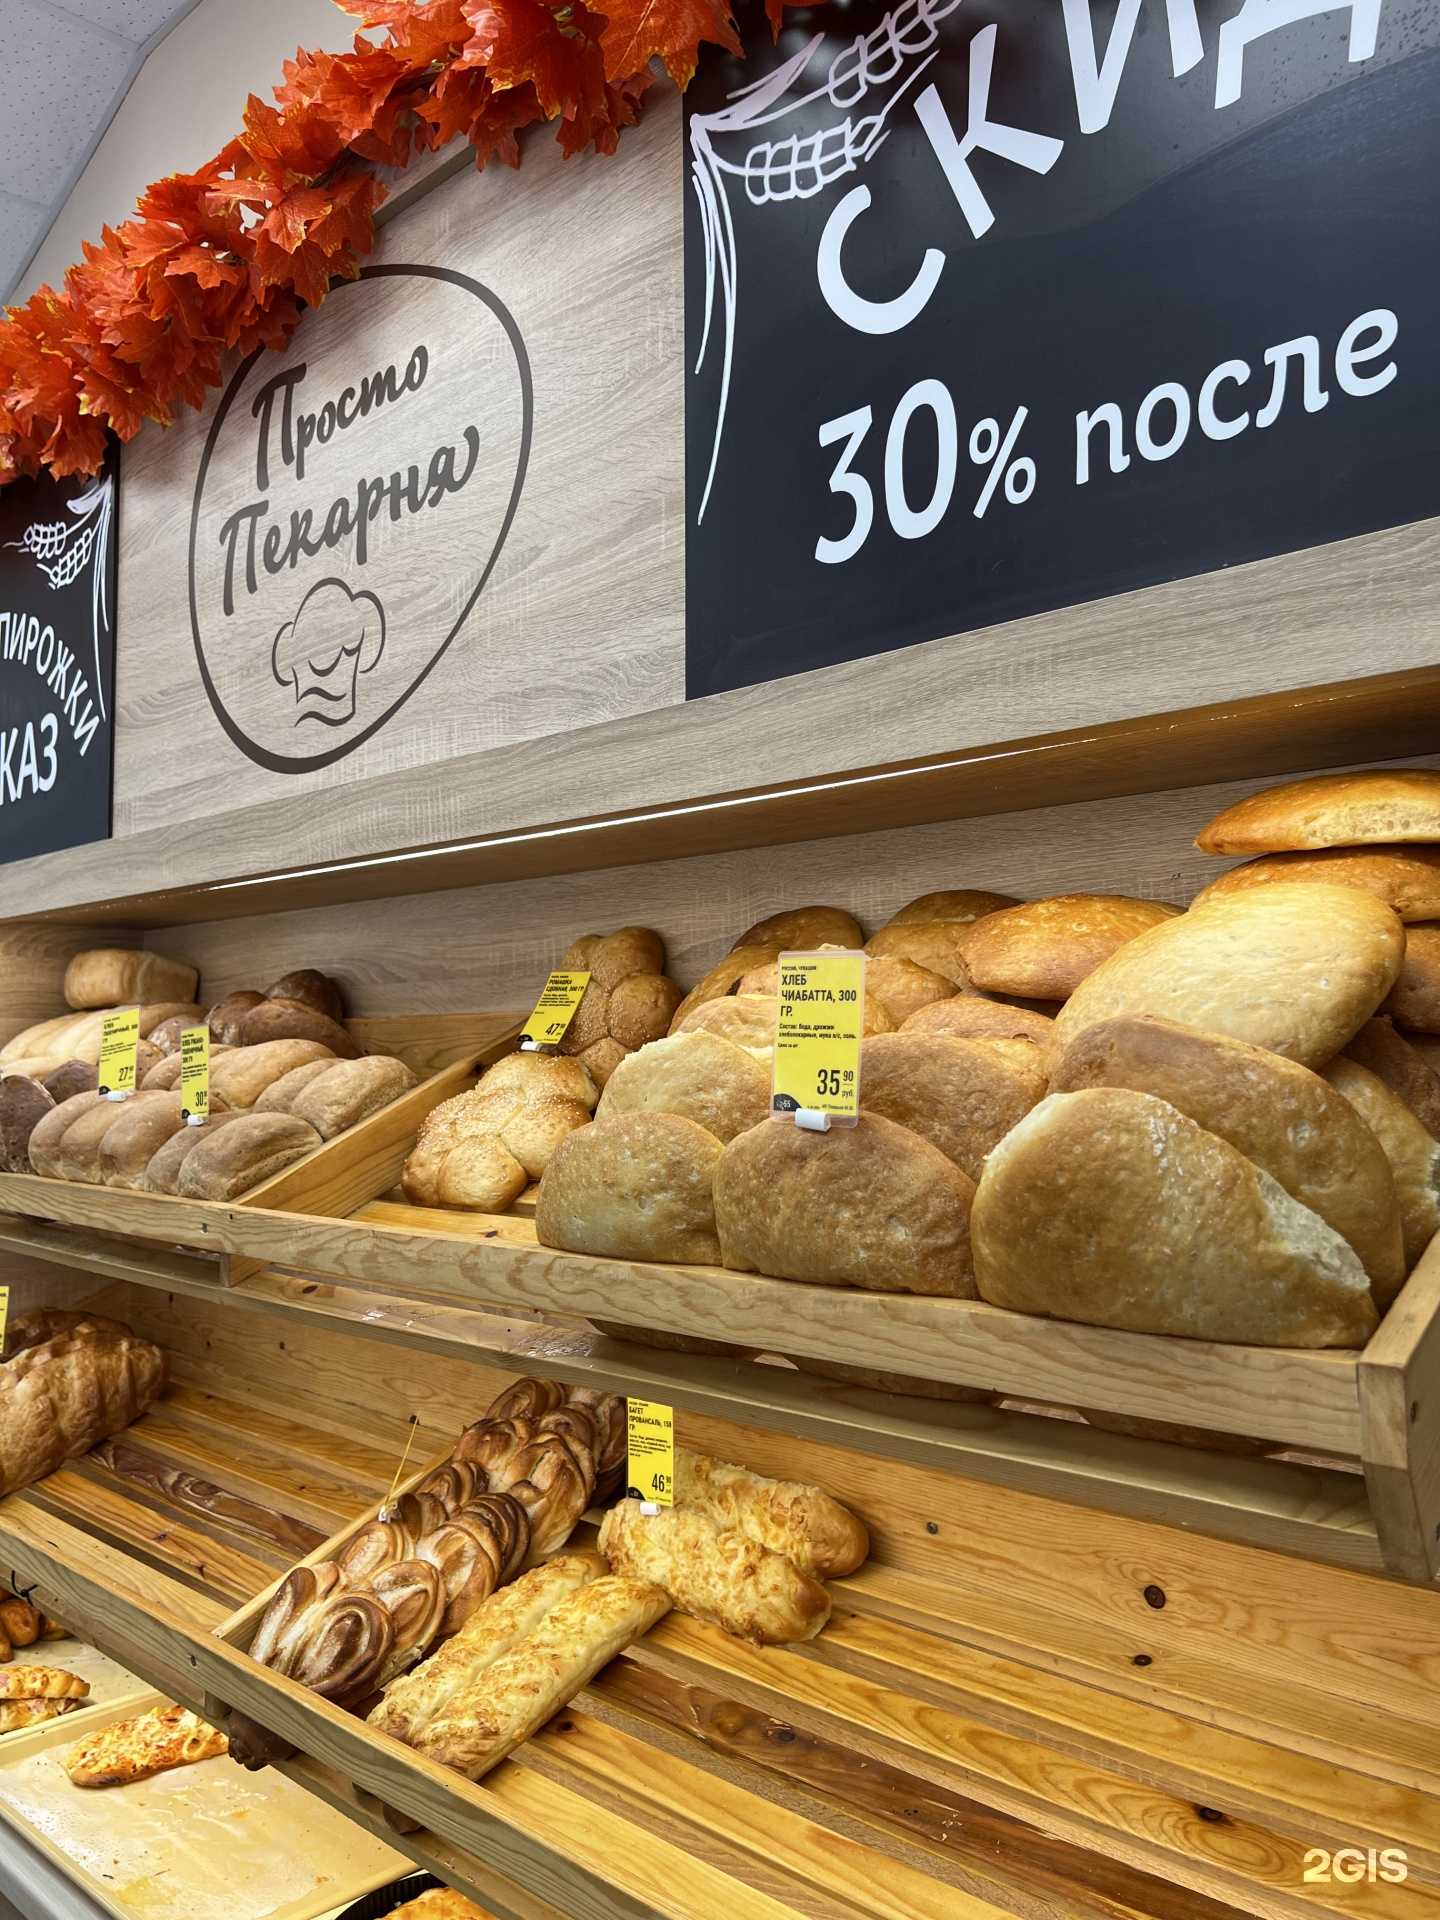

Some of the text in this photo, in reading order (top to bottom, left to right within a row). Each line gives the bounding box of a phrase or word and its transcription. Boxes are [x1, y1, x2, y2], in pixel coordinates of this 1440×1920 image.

[250, 345, 430, 490] Просто
[815, 308, 1400, 564] 30% после
[219, 425, 480, 616] Пекарня
[0, 612, 100, 758] ПИРОЖКИ
[781, 974, 807, 986] ХЛЕБ
[781, 989, 857, 1003] ЧИАБАТТА, 300
[780, 1006, 793, 1017] ГР.
[545, 1023, 560, 1035] 47
[118, 1066, 129, 1082] 27
[816, 1068, 854, 1096] 35 90
[195, 1090, 204, 1107] 30
[651, 1473, 665, 1492] 46
